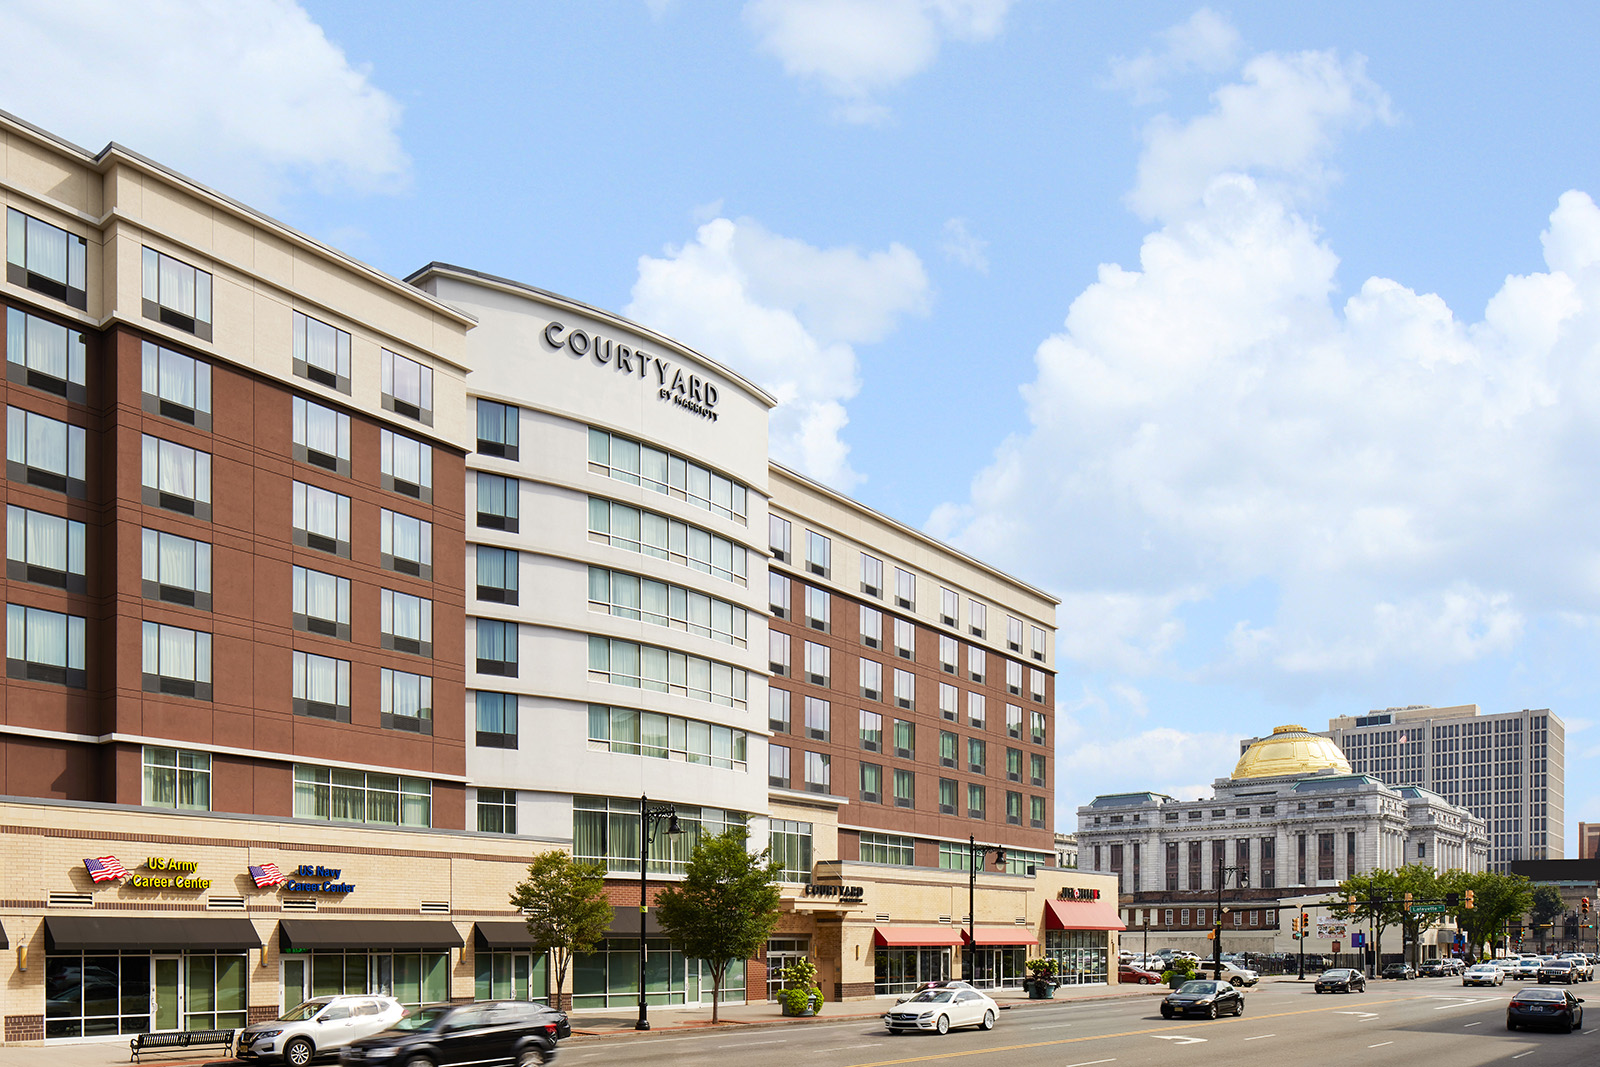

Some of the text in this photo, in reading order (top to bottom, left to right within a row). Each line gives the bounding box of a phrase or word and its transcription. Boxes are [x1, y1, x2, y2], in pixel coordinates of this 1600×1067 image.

[544, 321, 719, 407] COURTYARD
[659, 388, 719, 421] BY MARRIOTT
[147, 857, 198, 874] US Army
[298, 865, 341, 880] US Navy
[132, 874, 213, 889] Career Center
[288, 880, 355, 893] Career Center
[805, 885, 863, 897] COURTYARD
